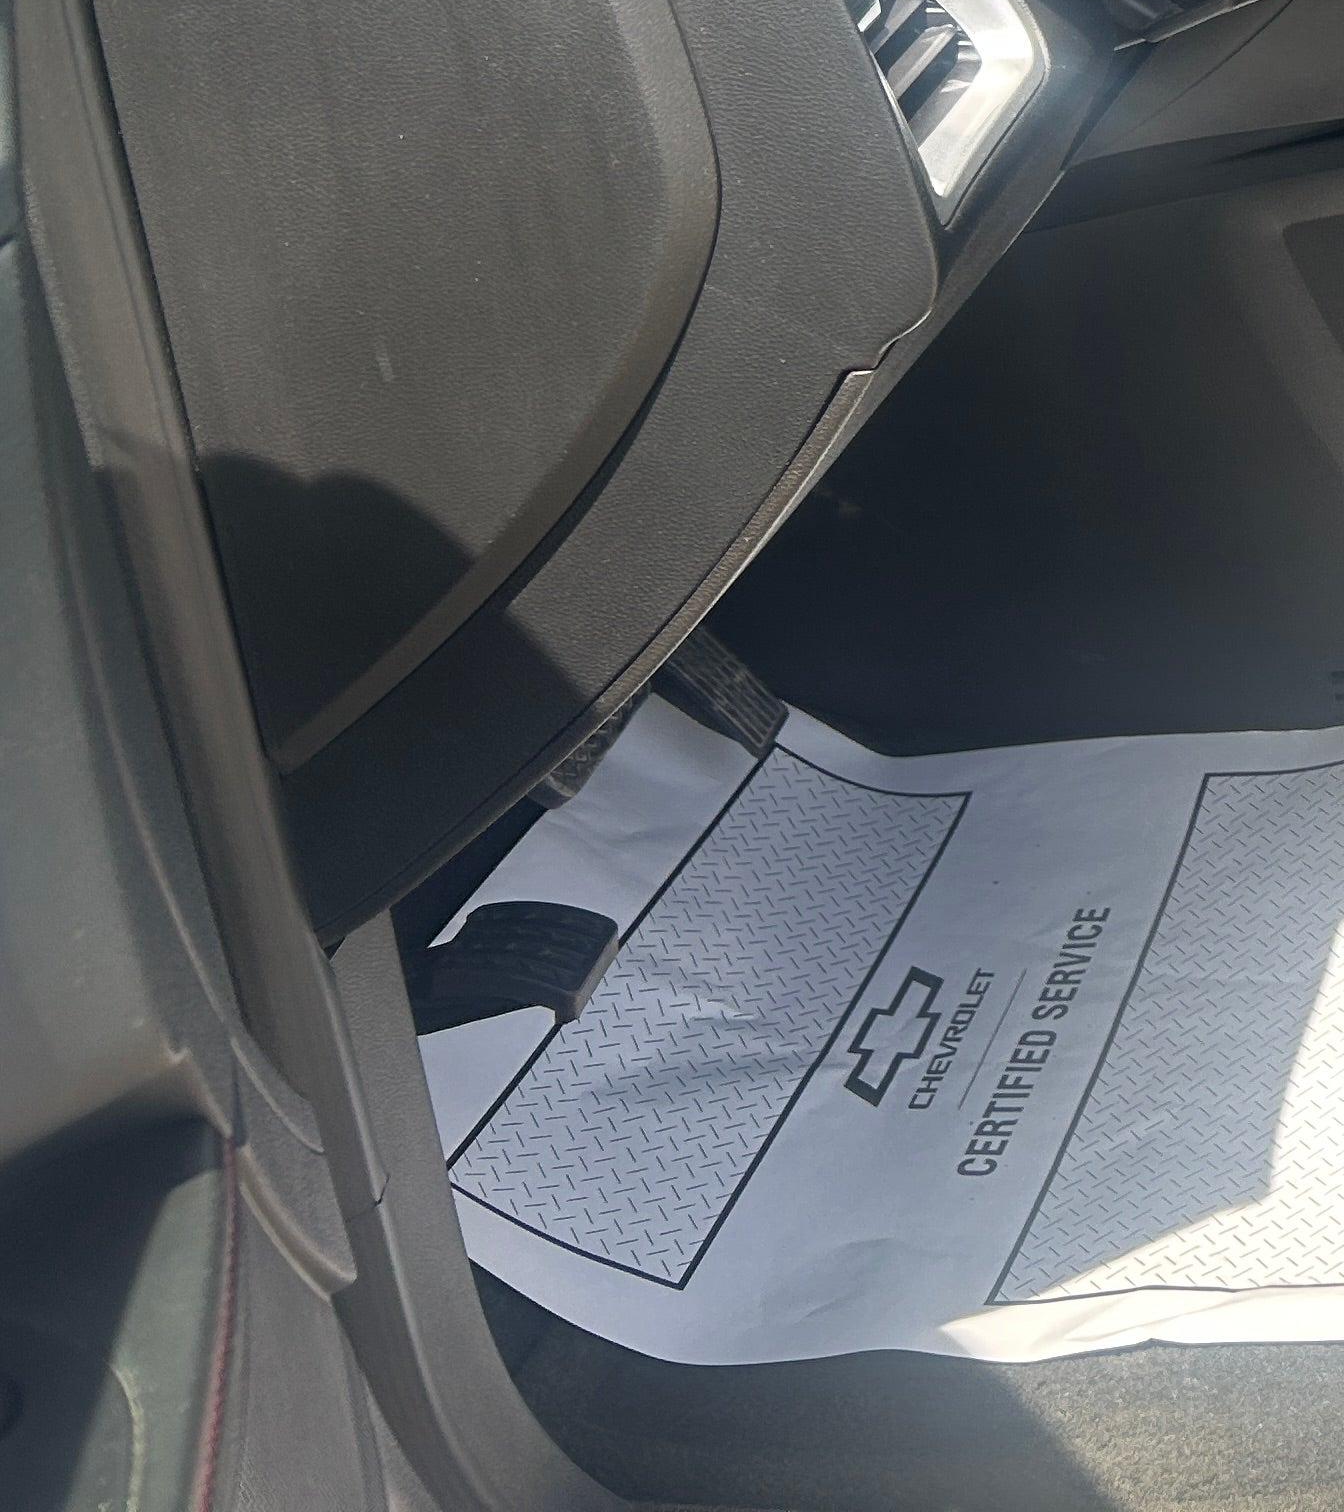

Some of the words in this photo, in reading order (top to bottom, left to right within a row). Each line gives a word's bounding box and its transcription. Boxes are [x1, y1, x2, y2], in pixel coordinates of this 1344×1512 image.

[908, 968, 994, 1110] CHEVROLET
[956, 1030, 1056, 1177] CERTIFIED
[1031, 907, 1110, 1021] SERVICE
